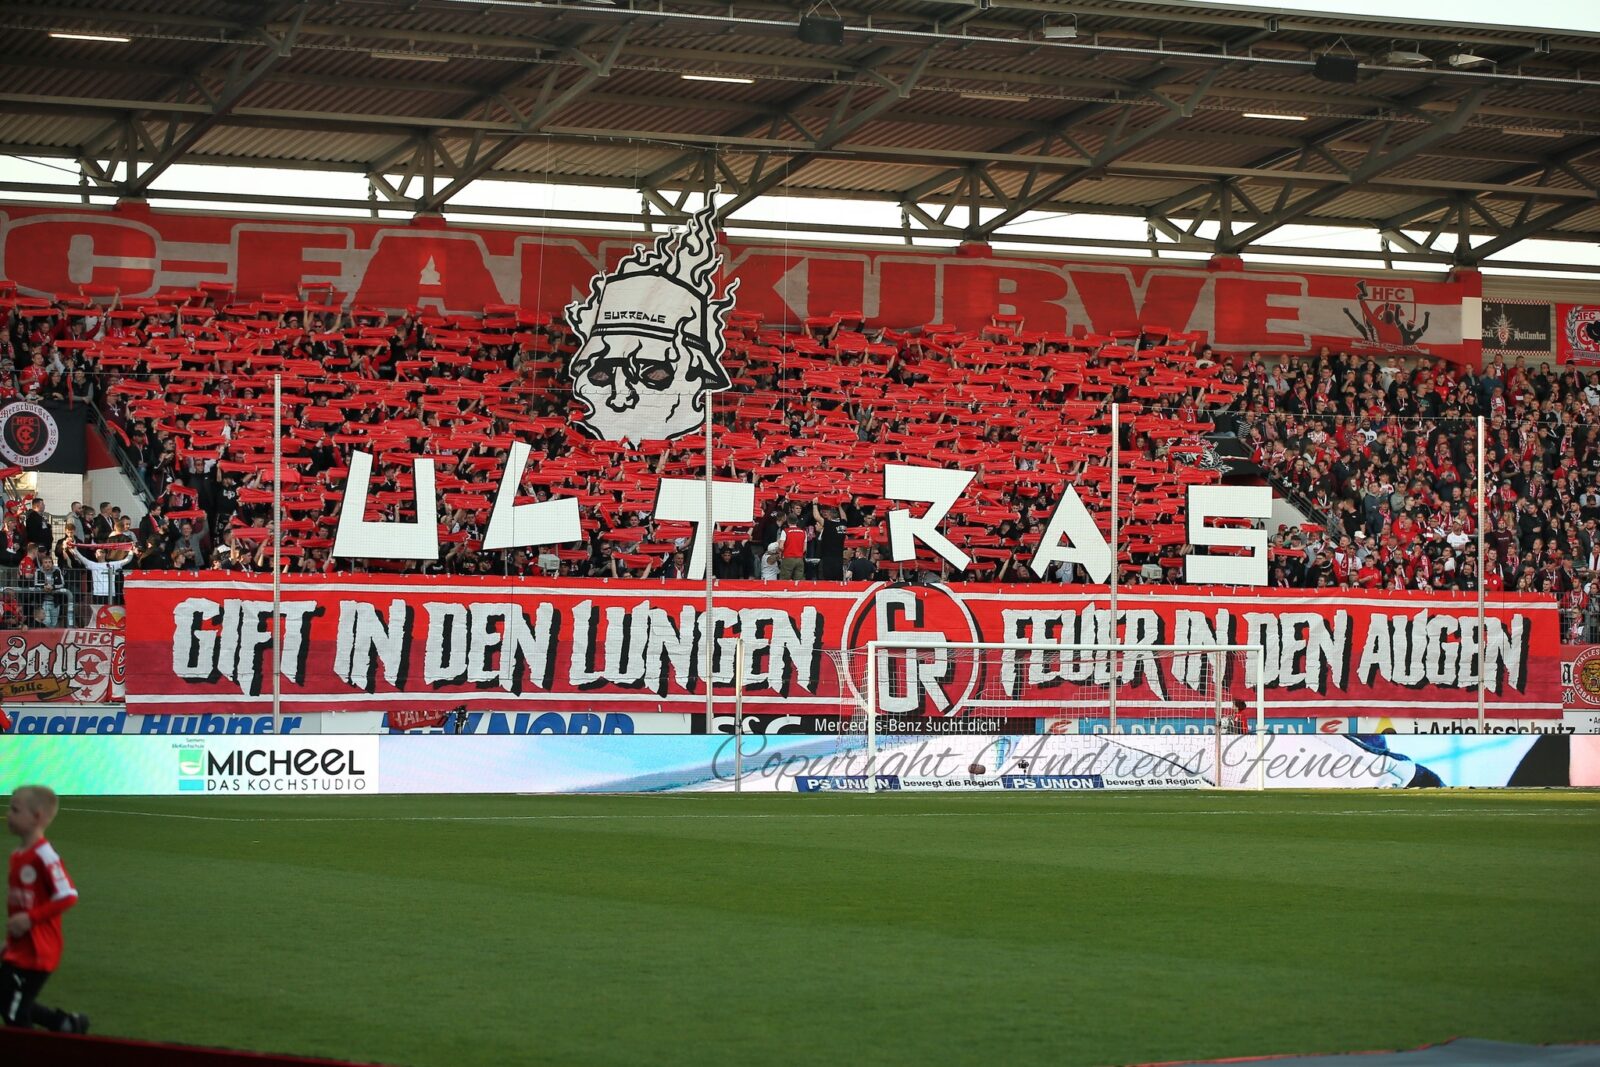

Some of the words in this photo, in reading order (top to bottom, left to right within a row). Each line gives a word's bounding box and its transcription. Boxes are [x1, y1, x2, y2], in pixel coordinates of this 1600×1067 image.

[1371, 286, 1406, 301] HFC
[74, 631, 112, 644] HFC
[173, 597, 322, 696] GIFT
[333, 598, 411, 692] IN
[422, 601, 558, 695] DEN
[569, 599, 821, 697] LUNGEN
[1001, 601, 1168, 700] FEUER
[1170, 607, 1235, 693] IN
[1243, 608, 1351, 695] DEN
[1357, 608, 1528, 697] AUGEN
[814, 718, 922, 732] Merceds-Benz
[926, 718, 959, 732] sucht
[960, 717, 1001, 732] dich!
[207, 778, 241, 791] DAS
[247, 778, 366, 792] KOCHSTUDIO
[903, 779, 943, 788] bewegt
[945, 779, 960, 787] die
[964, 778, 1000, 788] Region
[1040, 778, 1094, 789] UNION
[1106, 778, 1145, 787] bewegt
[1149, 778, 1163, 786] die
